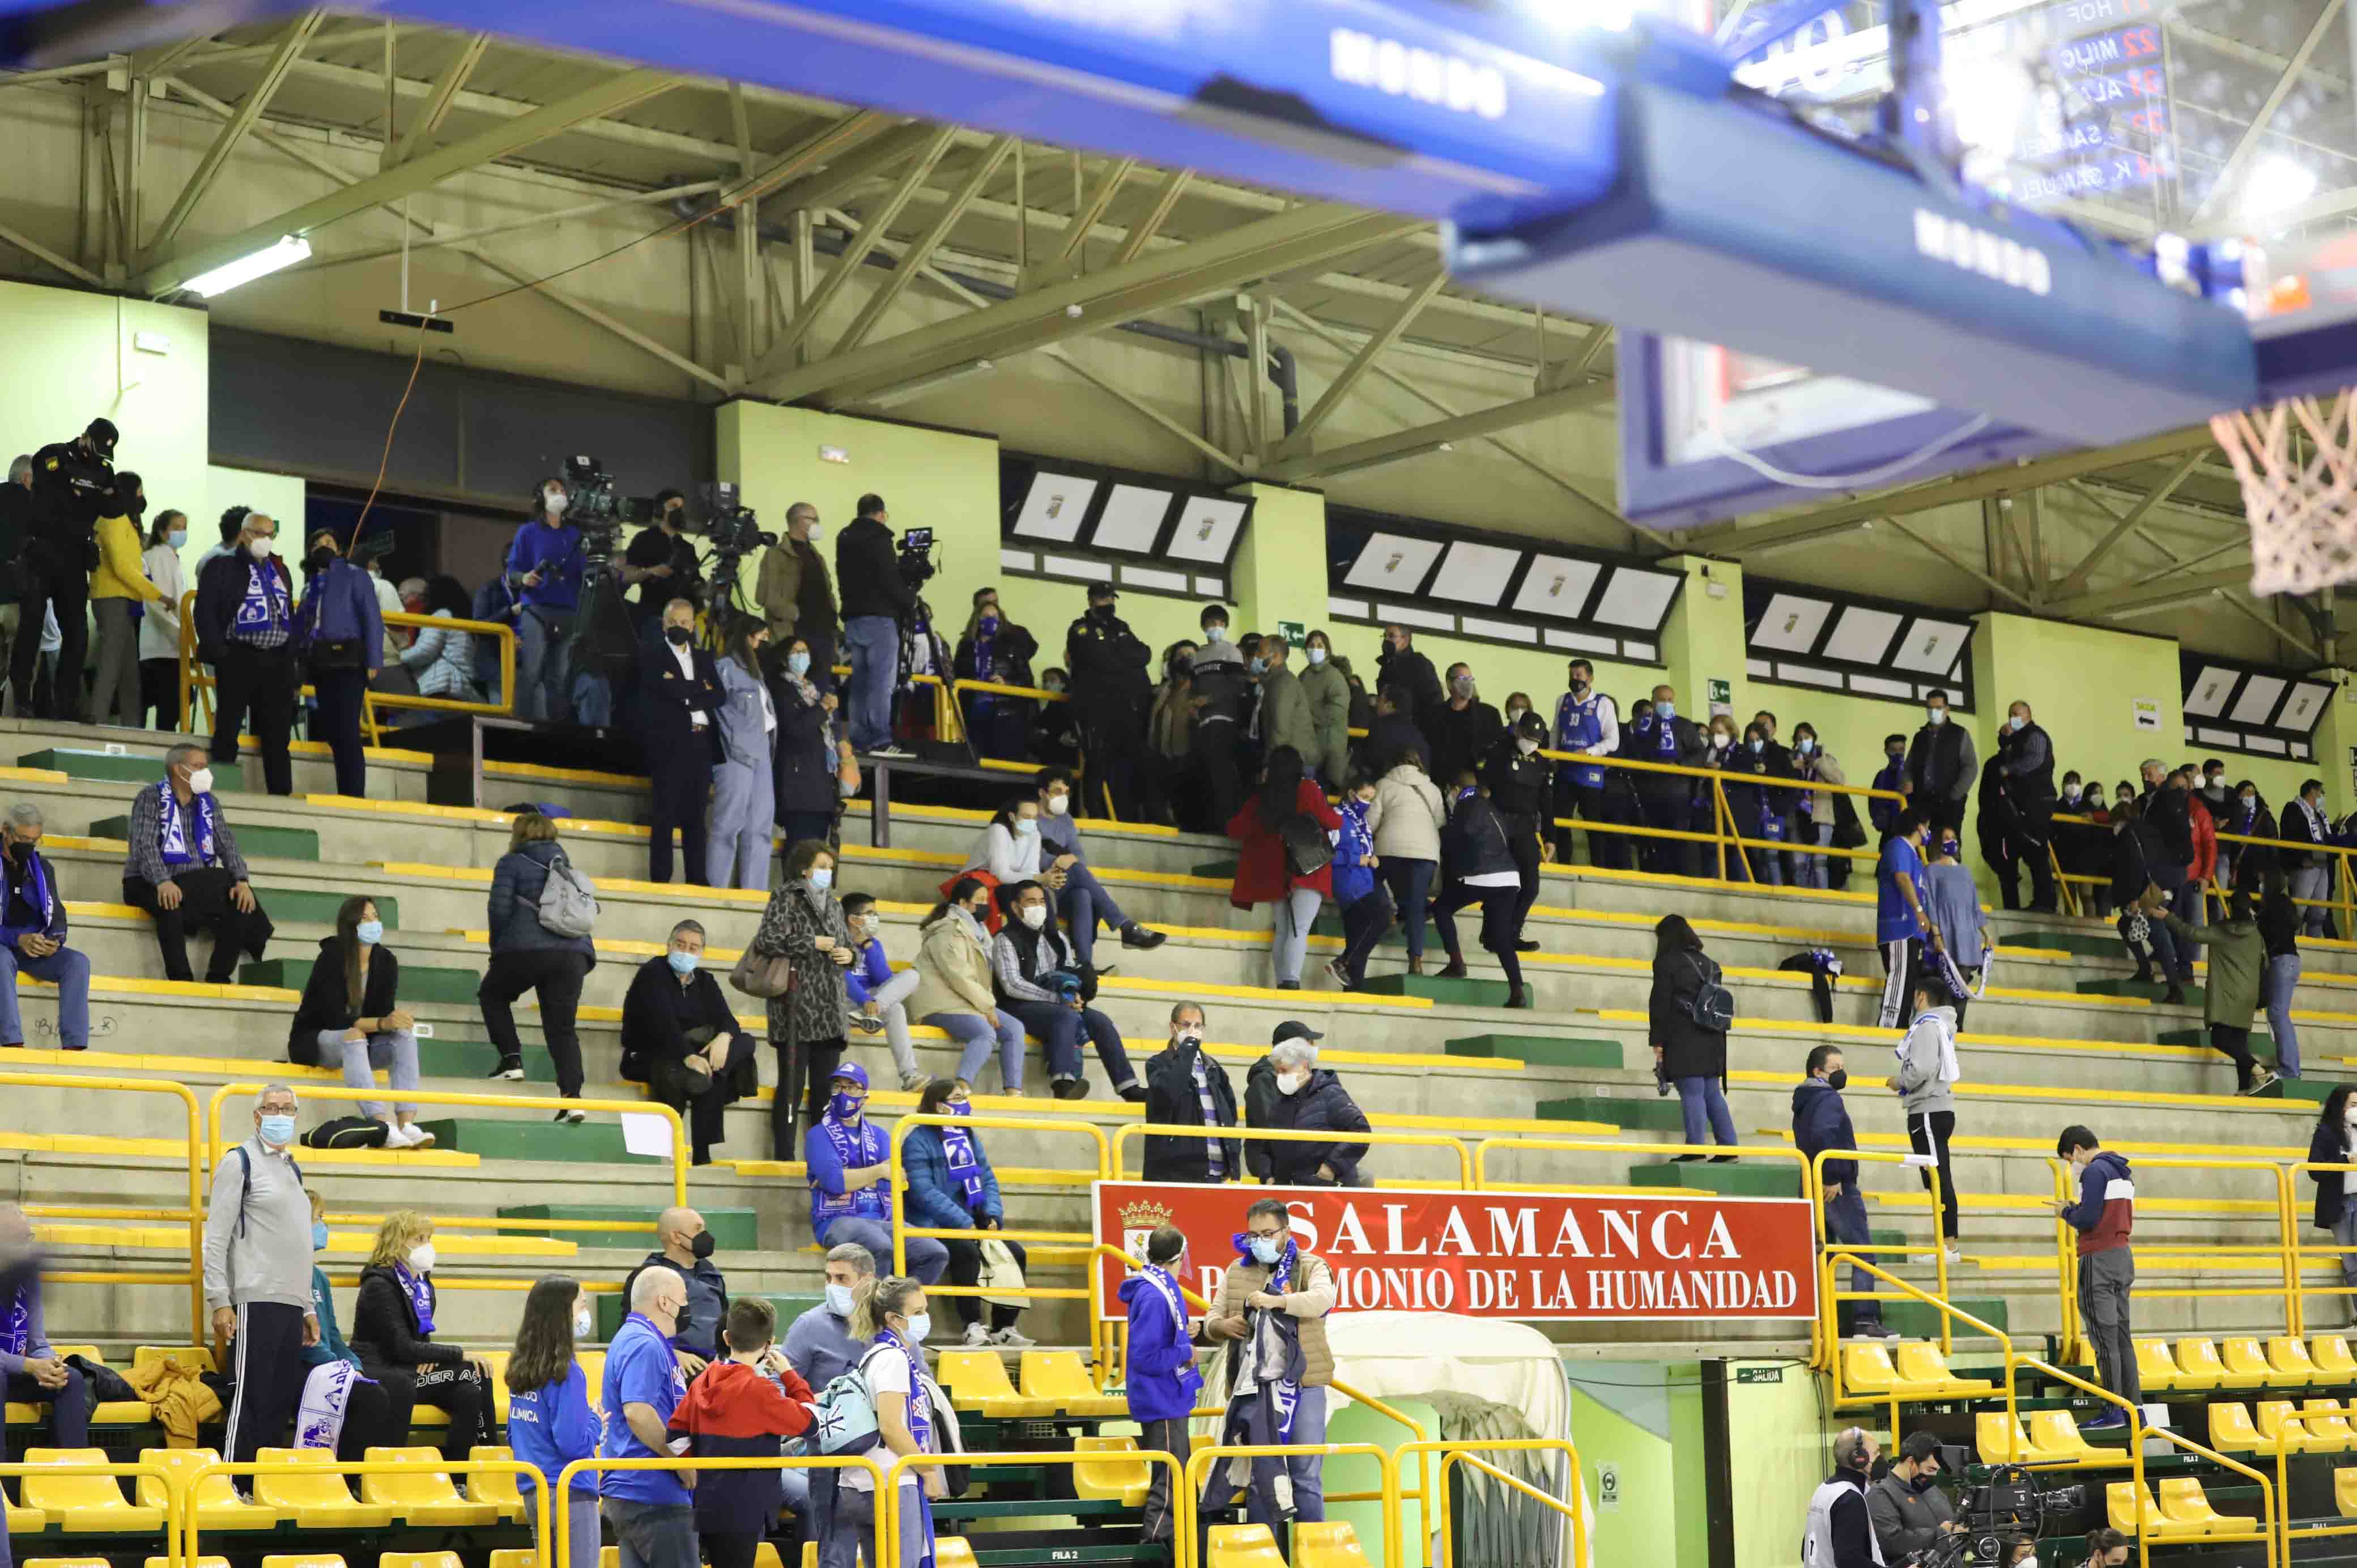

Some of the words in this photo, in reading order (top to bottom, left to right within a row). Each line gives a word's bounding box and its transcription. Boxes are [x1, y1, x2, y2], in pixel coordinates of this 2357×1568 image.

[1288, 1200, 1742, 1259] SALAMANCA
[1198, 1266, 1454, 1310] PMONIO
[1467, 1269, 1519, 1309] DE
[1530, 1269, 1578, 1309] LA
[1586, 1270, 1798, 1310] HUMANIDAD
[1752, 1369, 1780, 1382] SALIDA
[1052, 1550, 1071, 1560] FILA
[1071, 1550, 1078, 1560] 2
